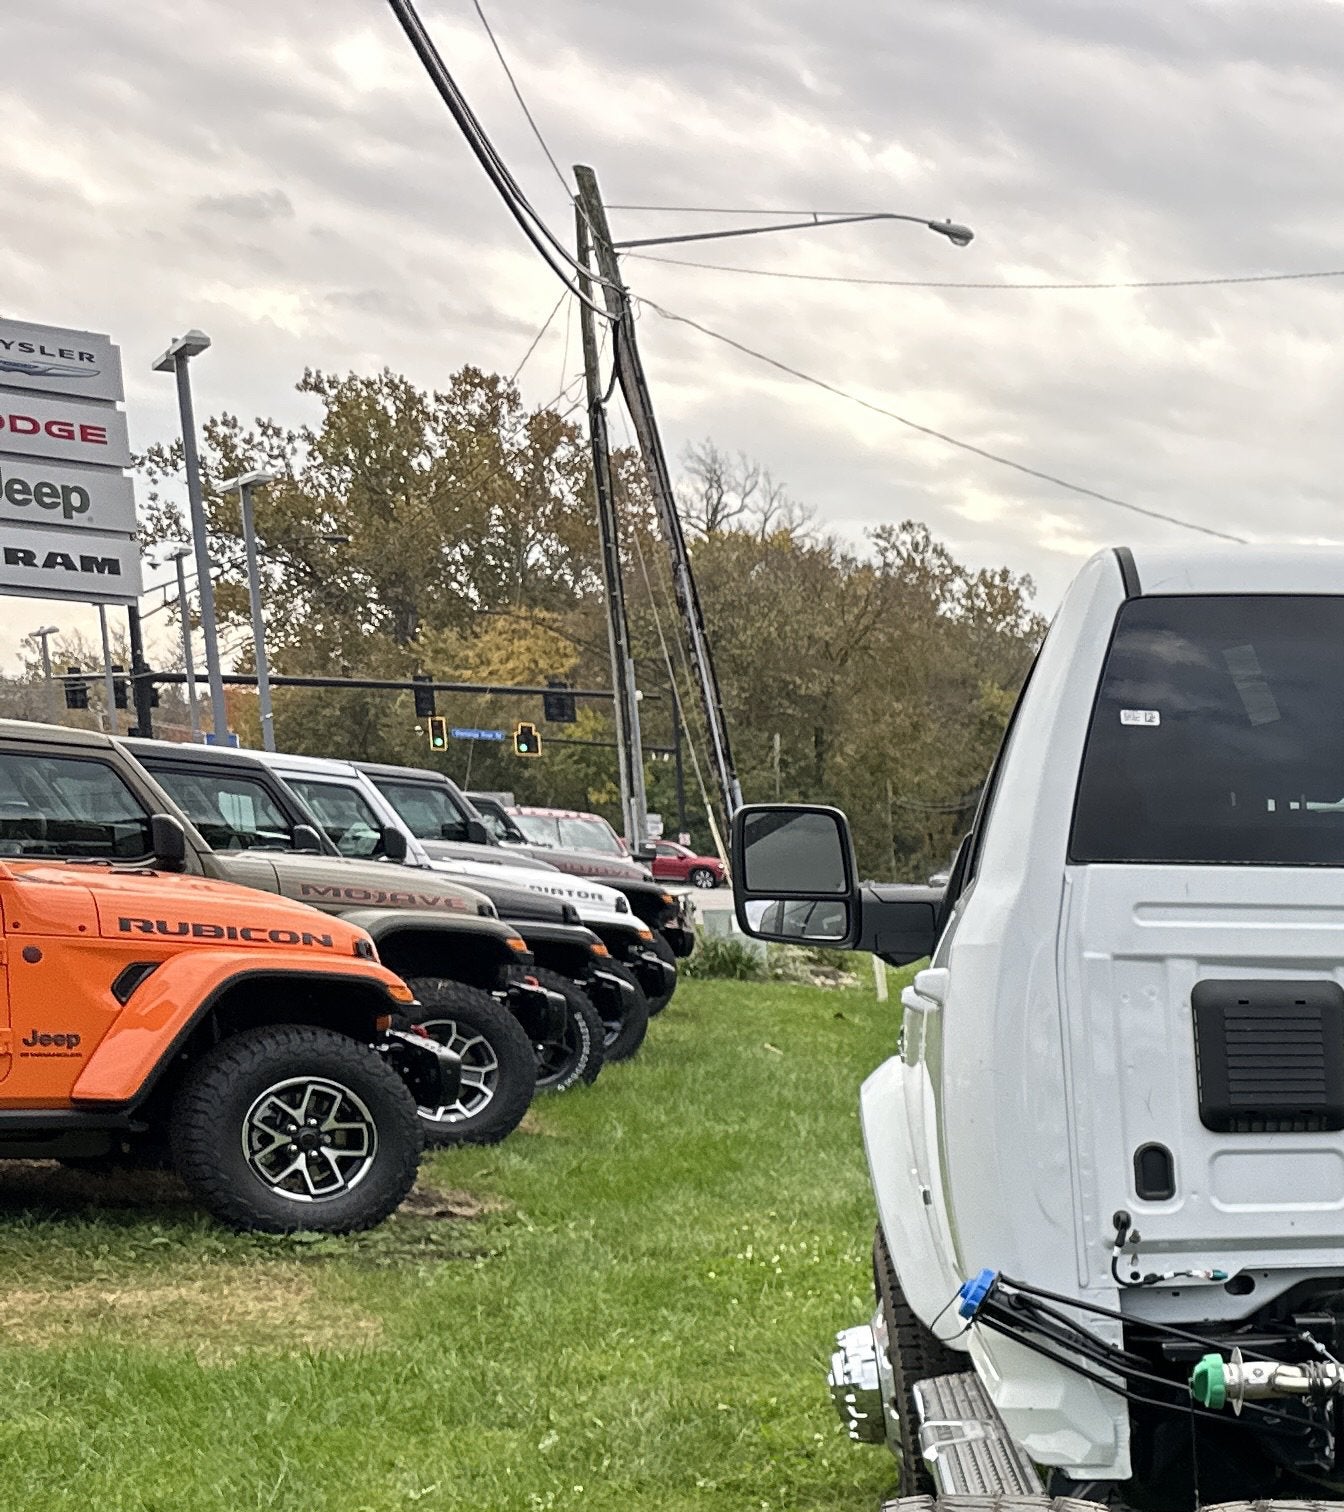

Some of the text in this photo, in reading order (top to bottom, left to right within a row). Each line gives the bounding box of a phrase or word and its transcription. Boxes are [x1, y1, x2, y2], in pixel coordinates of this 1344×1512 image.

[0, 414, 108, 445] DGE
[0, 466, 91, 519] eep
[3, 546, 121, 576] RAM
[301, 883, 467, 910] MOJAVE
[118, 916, 333, 947] RUBICON
[22, 1029, 81, 1050] Jeep
